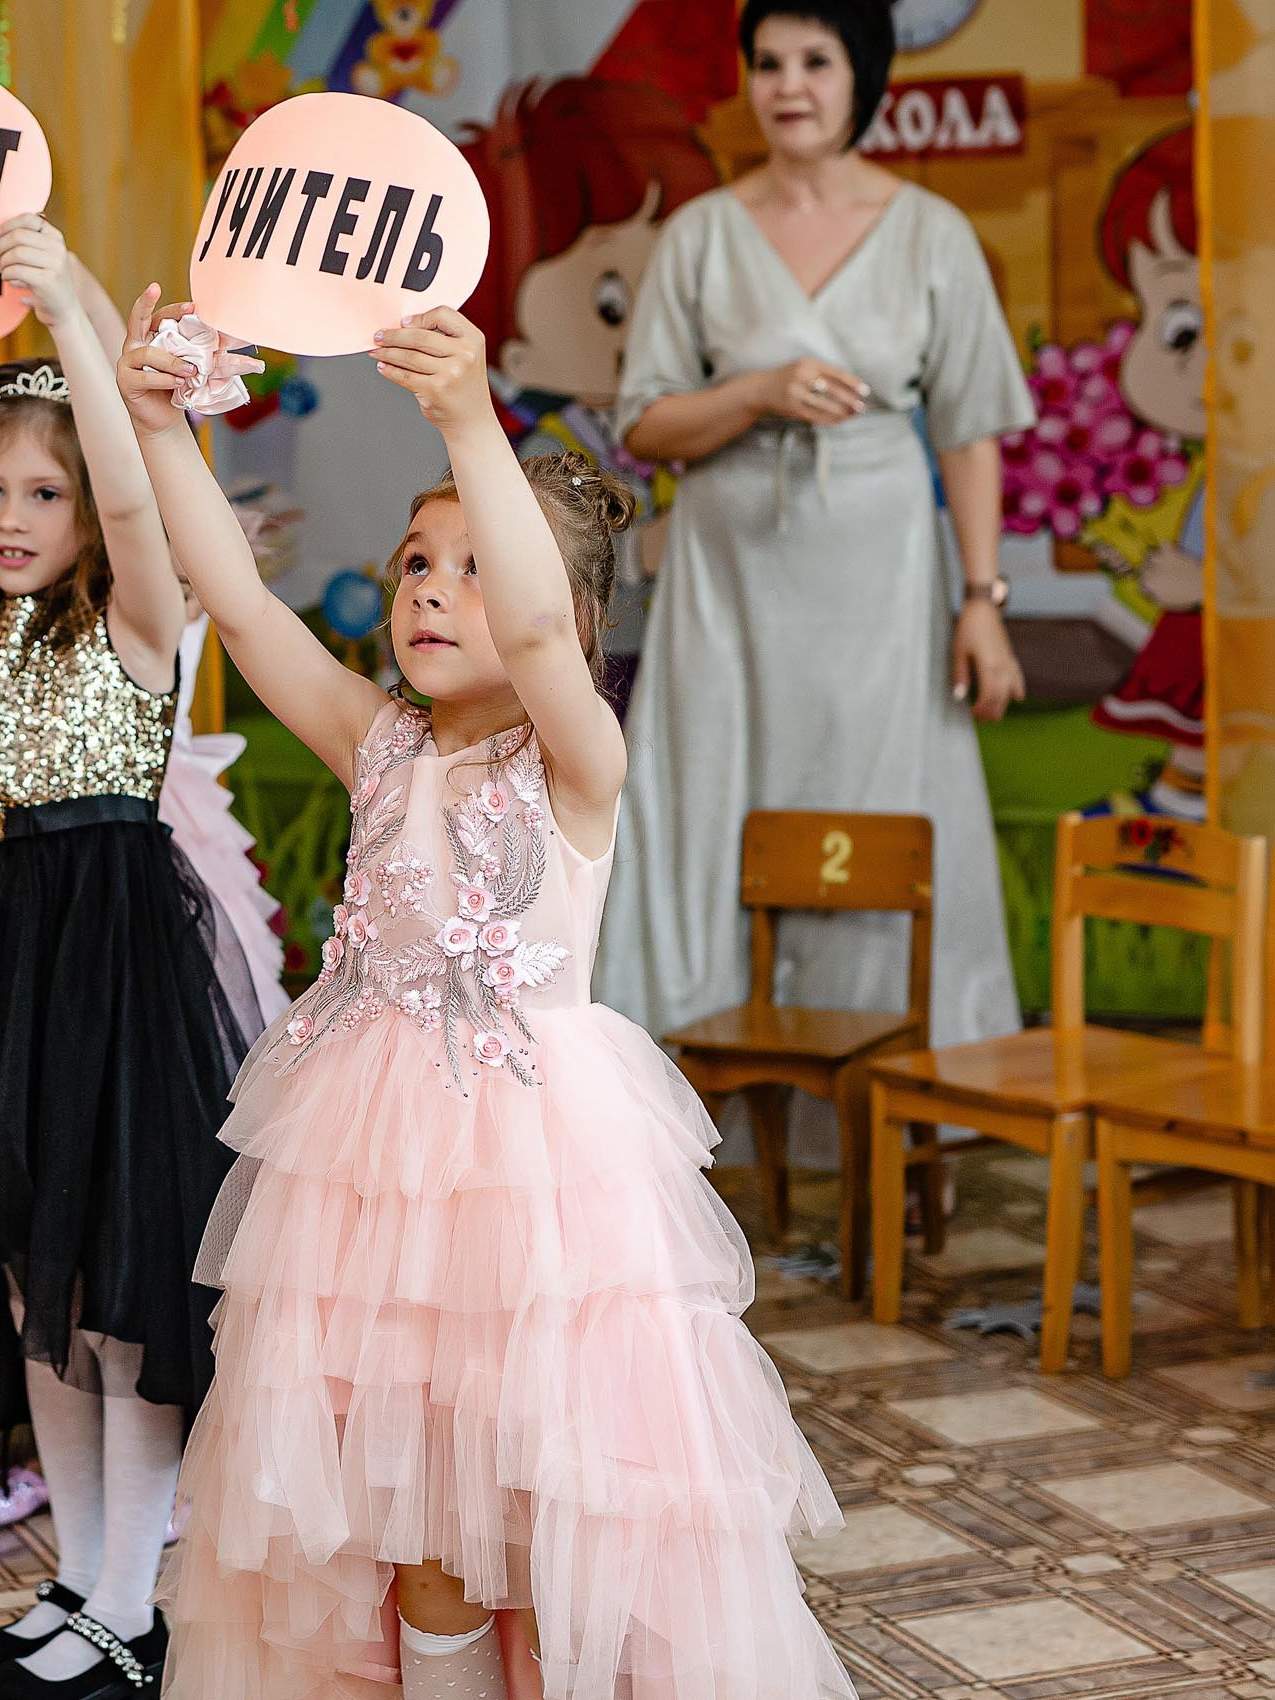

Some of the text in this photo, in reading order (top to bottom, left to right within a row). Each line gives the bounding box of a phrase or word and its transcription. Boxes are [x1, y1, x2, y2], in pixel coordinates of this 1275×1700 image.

[858, 84, 1021, 151] КОЛА
[198, 167, 444, 293] УЧИТЕЛЬ
[822, 831, 852, 884] 2
